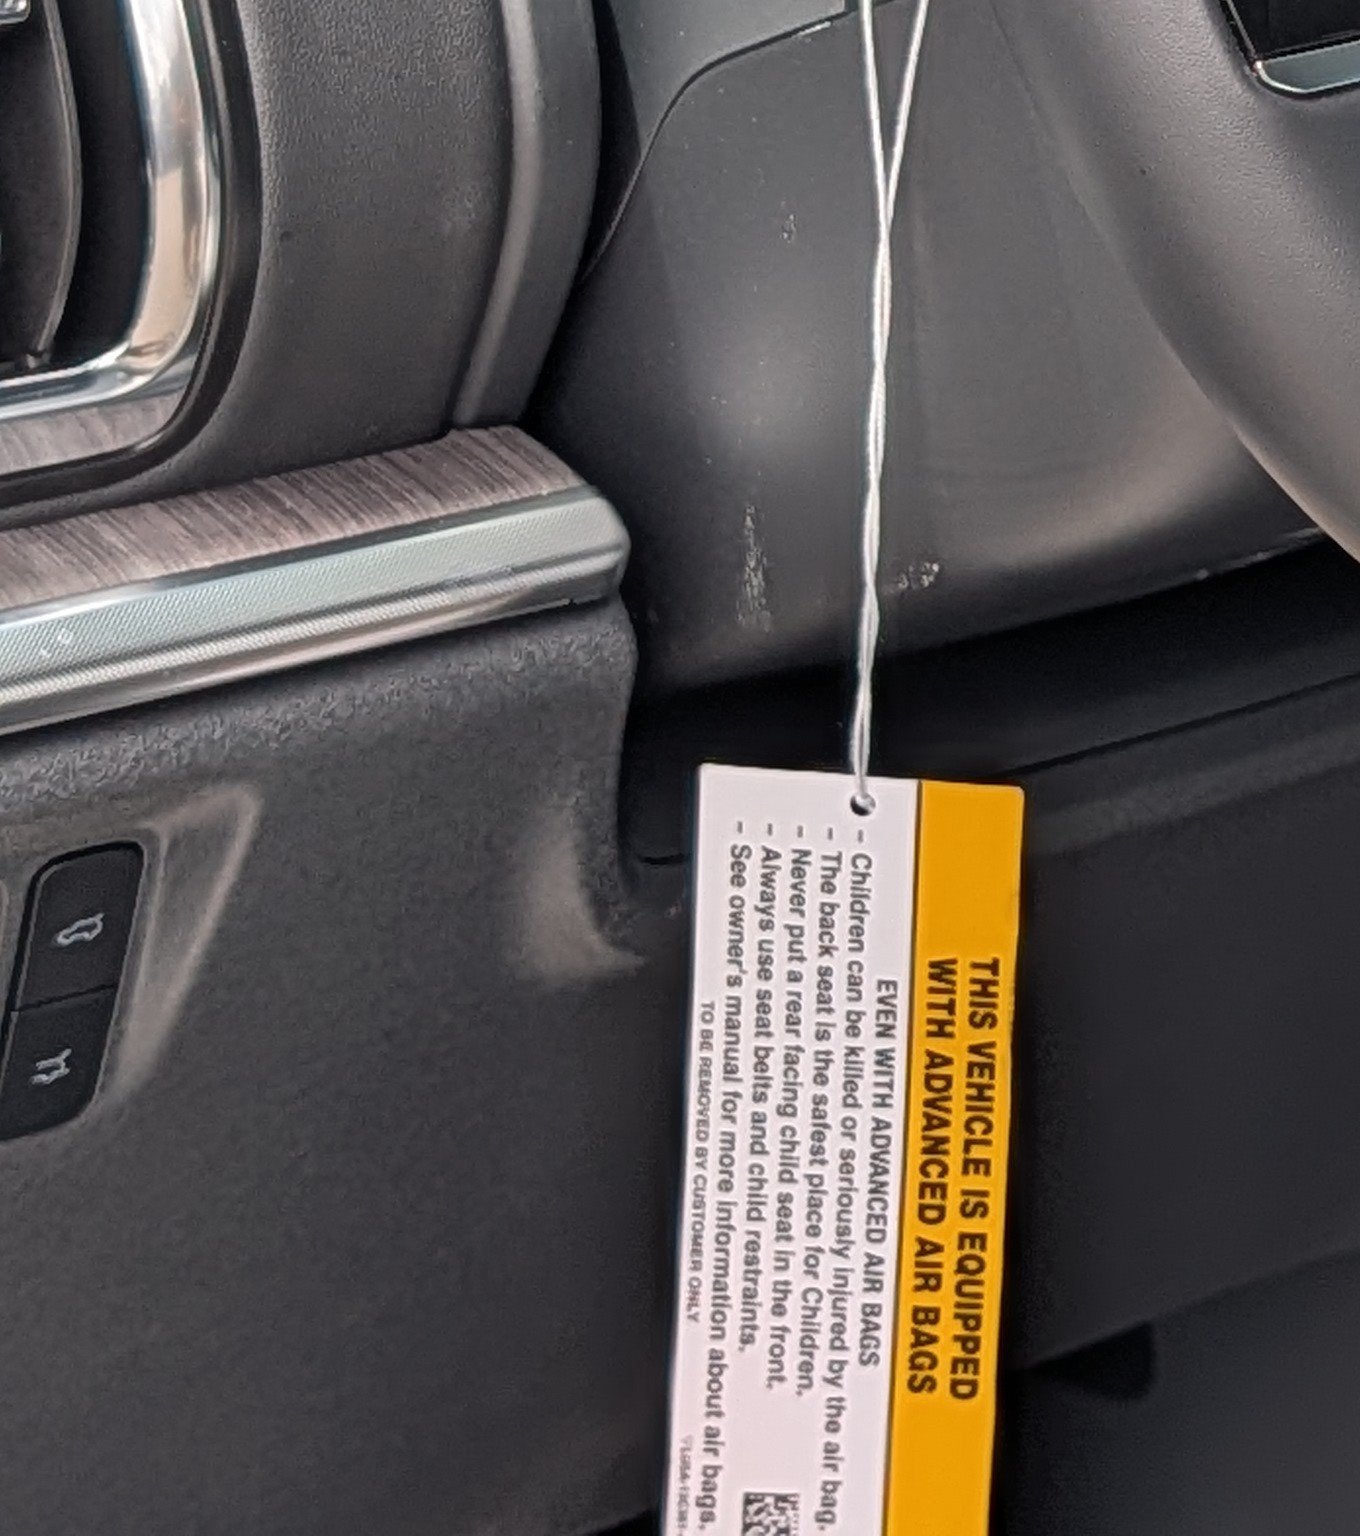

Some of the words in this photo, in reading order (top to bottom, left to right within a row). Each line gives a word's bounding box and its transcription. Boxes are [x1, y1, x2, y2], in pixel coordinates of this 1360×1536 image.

[729, 844, 753, 889] See
[754, 845, 783, 933] Always
[788, 848, 813, 919] Never
[819, 850, 843, 896] The
[817, 901, 841, 959] back
[847, 852, 873, 954] Children
[725, 894, 749, 989] owner's
[756, 938, 775, 983] use
[784, 923, 808, 964] put
[785, 969, 804, 984] a
[814, 964, 836, 1016] seat
[846, 960, 864, 1003] can
[925, 958, 959, 1040] WITH
[967, 957, 1000, 1030] THIS
[698, 1000, 716, 1026] TO
[753, 988, 775, 1039] seat
[784, 990, 803, 1039] rear
[814, 1021, 837, 1042] is
[844, 1009, 867, 1039] be
[874, 978, 899, 1040] EVEN
[698, 1028, 715, 1053] BE
[722, 995, 744, 1084] manual
[812, 1049, 836, 1088] the
[694, 1055, 713, 1144] REMOVED
[751, 1045, 775, 1104] belts
[775, 1044, 806, 1119] facing
[841, 1045, 866, 1110] killed
[871, 1047, 896, 1109] WITH
[720, 1090, 743, 1125] for
[749, 1110, 771, 1157] and
[808, 1093, 833, 1167] safest
[840, 1115, 858, 1142] or
[917, 1048, 955, 1226] ADVANCED
[960, 1040, 997, 1178] VEHICLE
[693, 1146, 709, 1171] BY
[716, 1130, 737, 1194] more
[777, 1124, 801, 1185] child
[864, 1115, 893, 1245] ADVANCED
[745, 1162, 769, 1223] child
[773, 1191, 795, 1243] seat
[803, 1173, 829, 1239] place
[828, 1147, 860, 1260] seriously
[958, 1188, 991, 1220] IS
[687, 1173, 708, 1273] CUSTOMER
[709, 1200, 738, 1341] information
[773, 1249, 796, 1273] in
[802, 1245, 826, 1281] for
[861, 1251, 886, 1294] AIR
[912, 1236, 945, 1293] AIR
[685, 1275, 703, 1324] ONLY
[738, 1229, 763, 1353] restraints.
[770, 1279, 793, 1318] the
[826, 1267, 856, 1352] injured
[949, 1231, 988, 1401] EQUIPPED
[766, 1325, 792, 1390] front.
[795, 1287, 824, 1397] Children.
[857, 1302, 883, 1367] BAGS
[906, 1305, 942, 1394] BAGS
[704, 1348, 729, 1419] about
[821, 1359, 850, 1389] by
[702, 1425, 726, 1458] air
[824, 1396, 847, 1434] the
[822, 1440, 845, 1473] air
[695, 1464, 724, 1531] bags.
[814, 1480, 843, 1531] bag.
